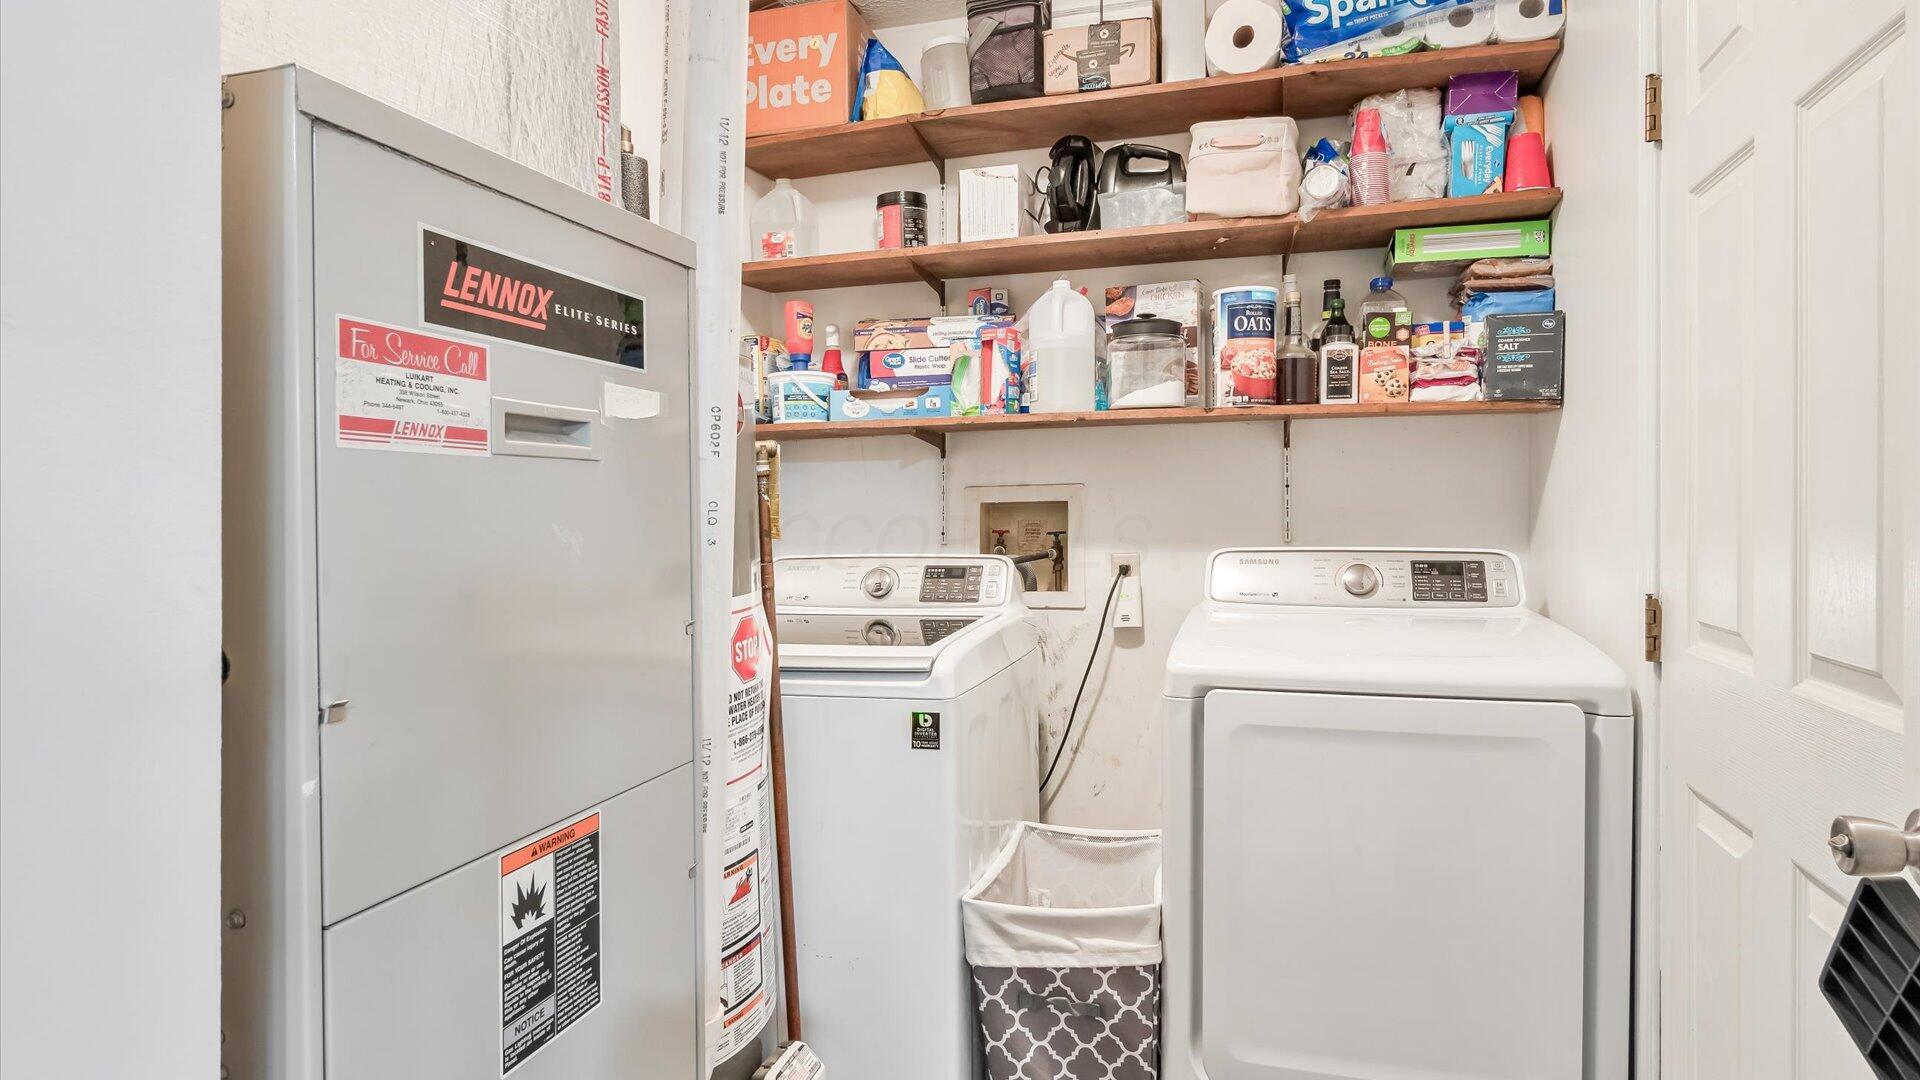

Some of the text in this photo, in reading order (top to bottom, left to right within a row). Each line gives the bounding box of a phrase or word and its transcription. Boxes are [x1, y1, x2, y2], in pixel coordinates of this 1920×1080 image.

[595, 0, 610, 39] FAST
[1369, 11, 1389, 21] POCKETS
[596, 64, 611, 124] FASSON
[719, 150, 728, 163] NOT
[1483, 145, 1494, 183] Everyday
[718, 165, 727, 179] FOR
[443, 260, 638, 335] LENNOX ELITE SERIES
[1233, 315, 1272, 332] OATS
[351, 327, 479, 377] For Service Call
[1497, 343, 1520, 351] SALT
[909, 355, 927, 364] Slide
[375, 377, 406, 388] HEATING
[408, 381, 413, 389] &
[405, 372, 434, 382] LUIKART
[427, 392, 440, 400] Street
[363, 400, 380, 408] Phone
[394, 420, 445, 439] LENNOX
[735, 636, 759, 663] STOP
[733, 690, 744, 702] NOT
[728, 701, 747, 716] WATER
[731, 708, 754, 726] PLACE OF
[912, 740, 922, 748] 10
[538, 828, 576, 854] WARNING
[514, 1007, 545, 1037] NOTICE
